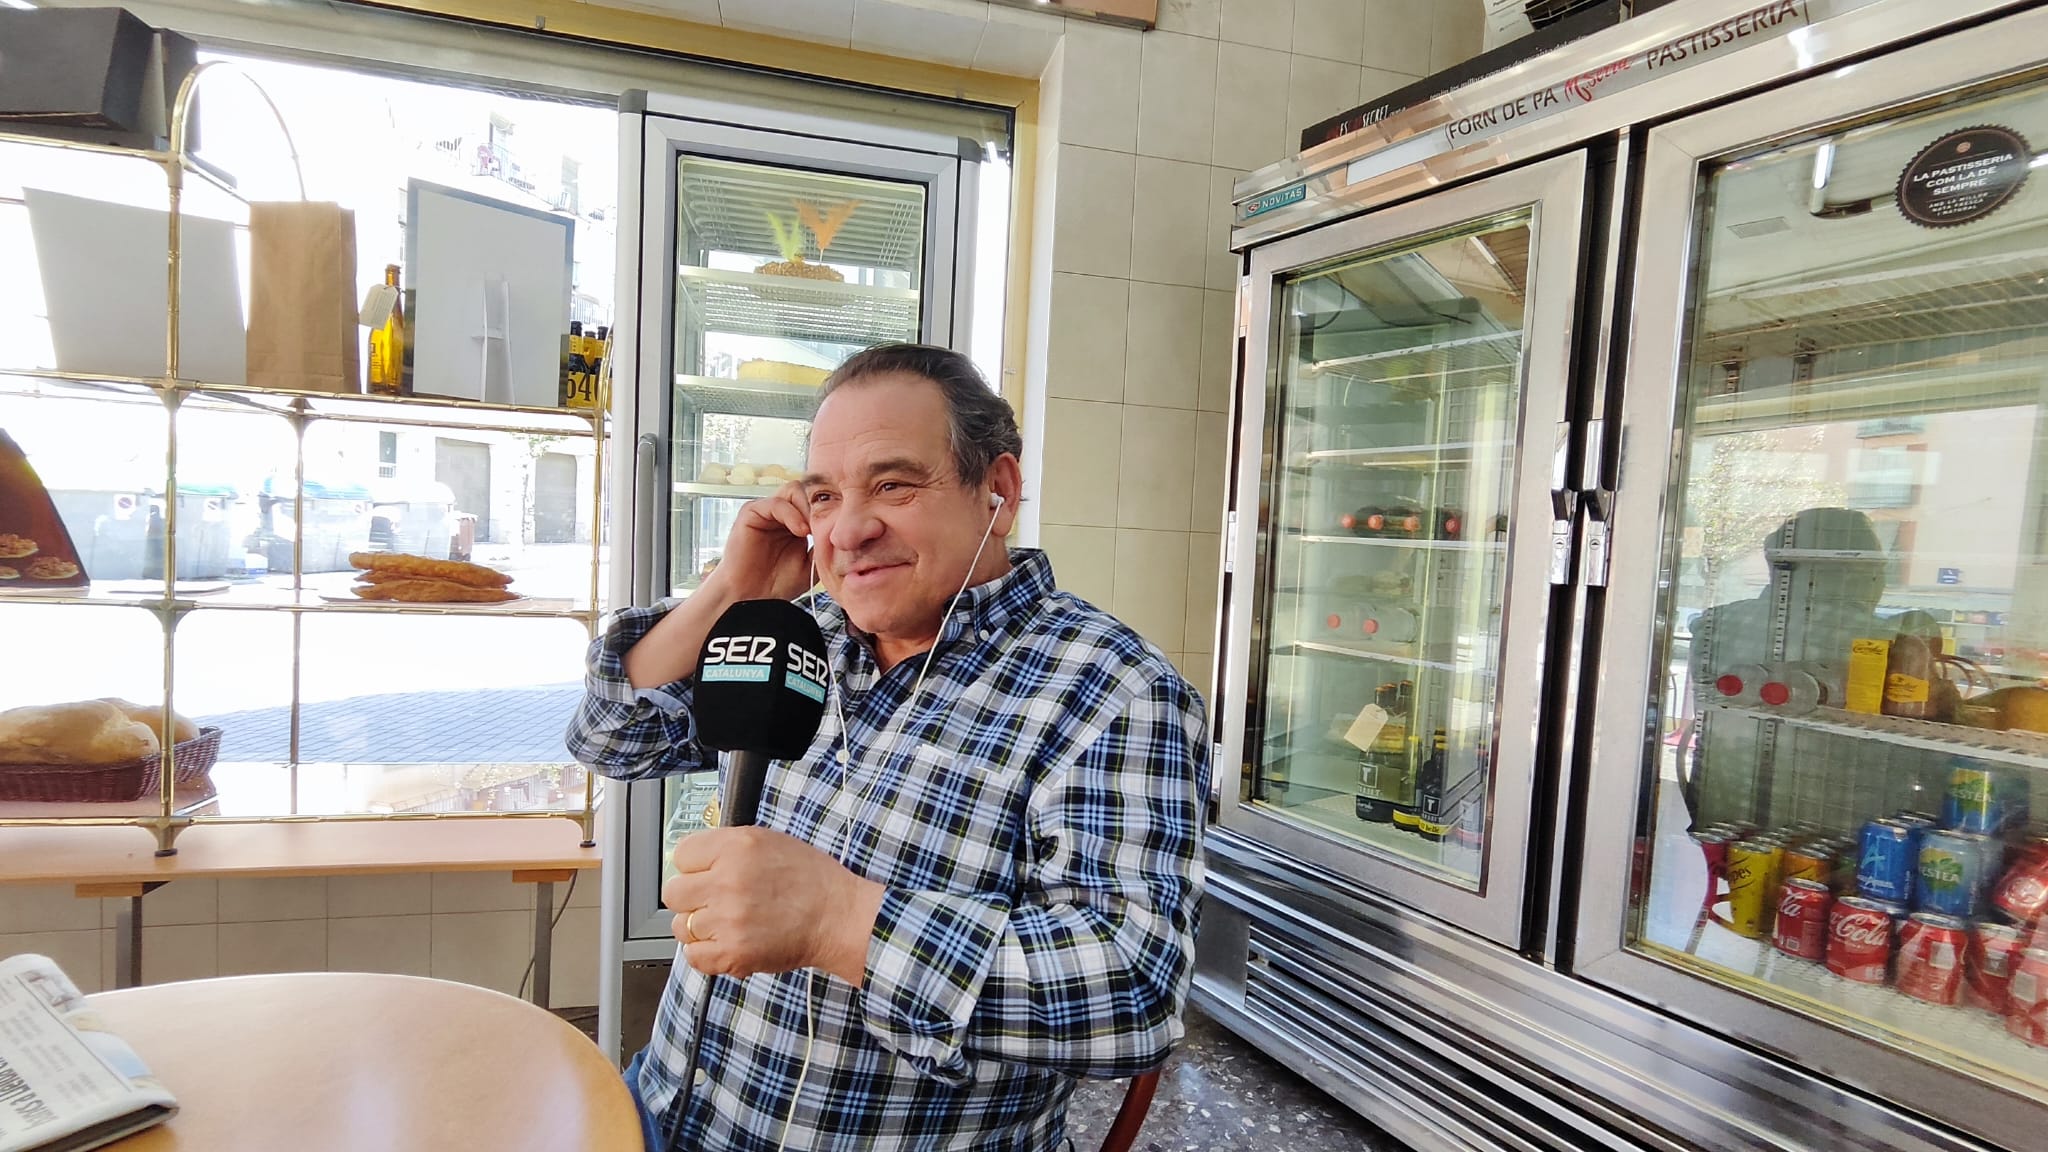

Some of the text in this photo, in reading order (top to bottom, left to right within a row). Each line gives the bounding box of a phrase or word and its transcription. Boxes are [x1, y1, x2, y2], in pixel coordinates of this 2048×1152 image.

[1449, 109, 1498, 139] FORN
[1503, 100, 1528, 121] DE
[1533, 88, 1559, 110] PA
[1647, 0, 1799, 70] PASTISSERIA
[1913, 153, 2013, 182] LA PASTISSERIA
[1926, 166, 1997, 188] COM LA DE
[1262, 187, 1302, 208] NOVITAS
[1933, 178, 1988, 196] SEMPRE
[704, 636, 777, 664] SER
[705, 668, 765, 679] CATALUNYA
[786, 642, 830, 688] SER
[1920, 867, 1961, 883] ESTEA
[1836, 913, 1890, 946] Cola
